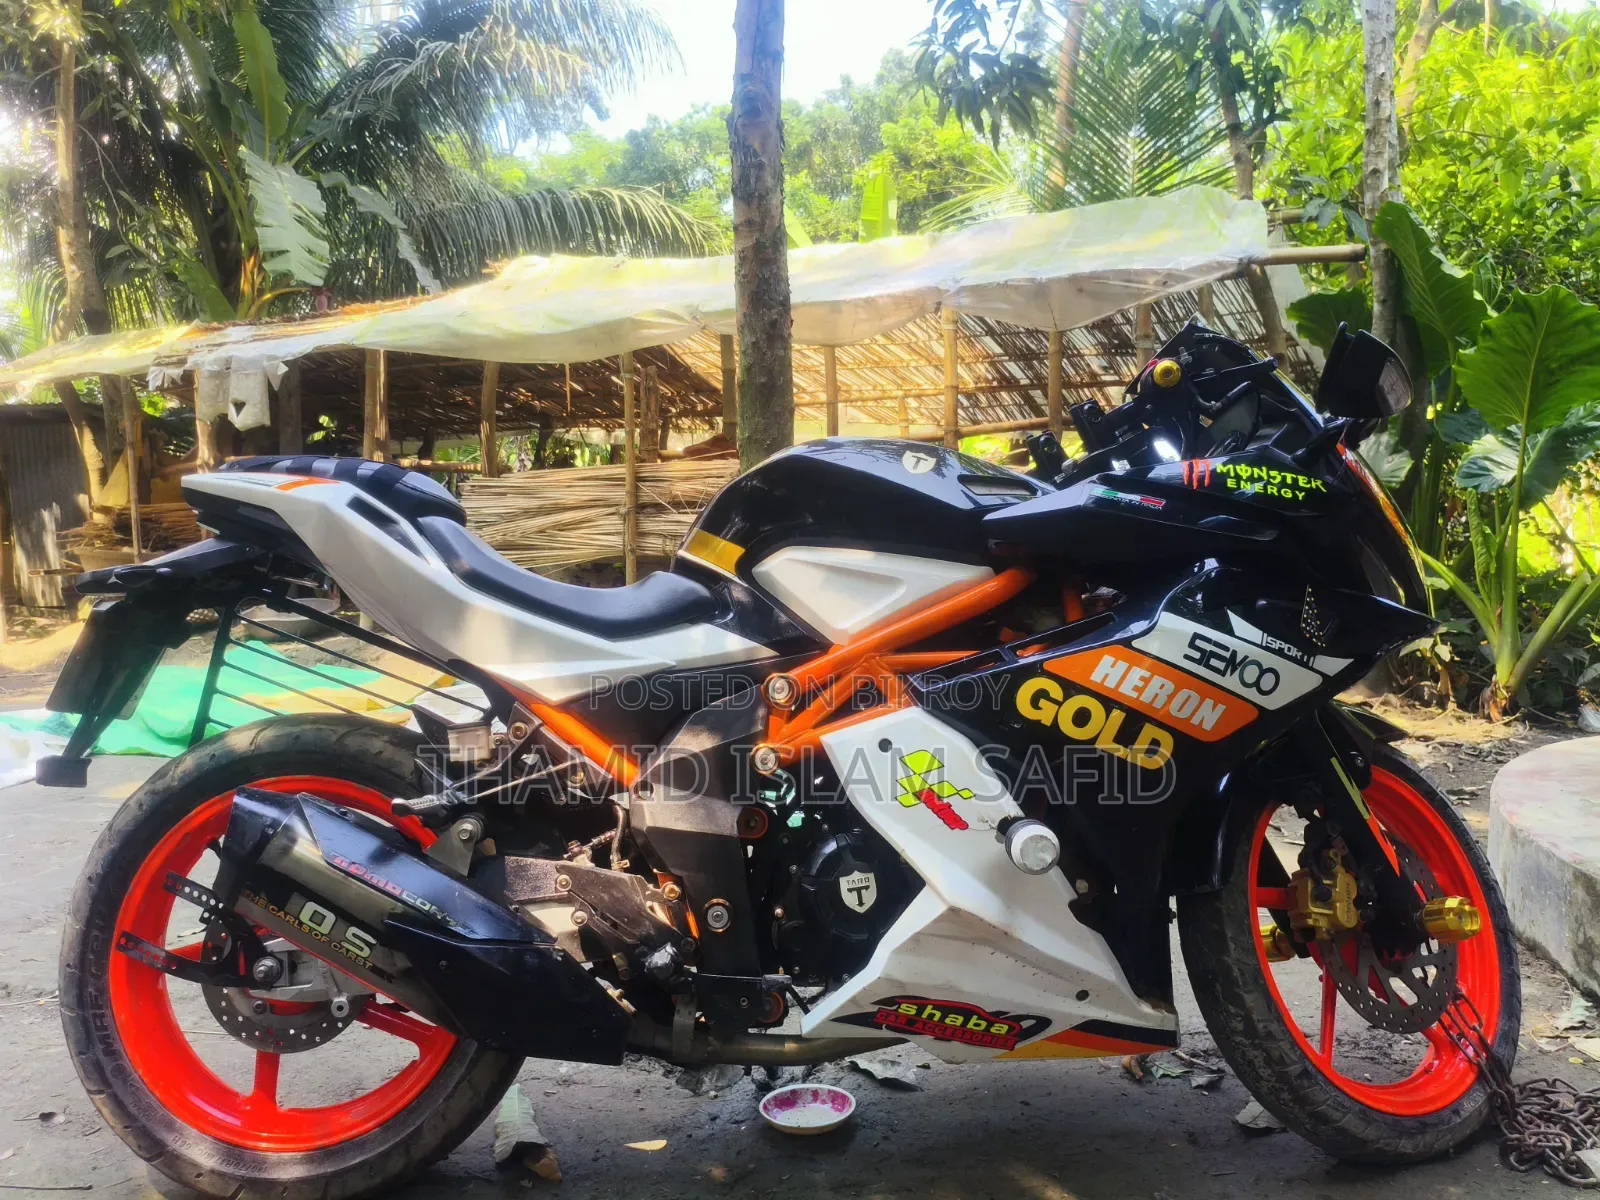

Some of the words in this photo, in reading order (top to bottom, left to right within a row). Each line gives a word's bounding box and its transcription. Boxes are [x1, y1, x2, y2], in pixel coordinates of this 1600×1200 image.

[1215, 463, 1327, 493] MONSTER
[1227, 479, 1306, 500] ENERGY
[1089, 655, 1226, 732] HERON
[1015, 677, 1175, 770] GOLD
[243, 889, 268, 909] THE
[268, 903, 310, 934] CARLS
[311, 931, 331, 945] OF
[330, 941, 373, 970] CARST
[876, 1011, 907, 1026] CAR
[898, 1002, 1009, 1035] shaba
